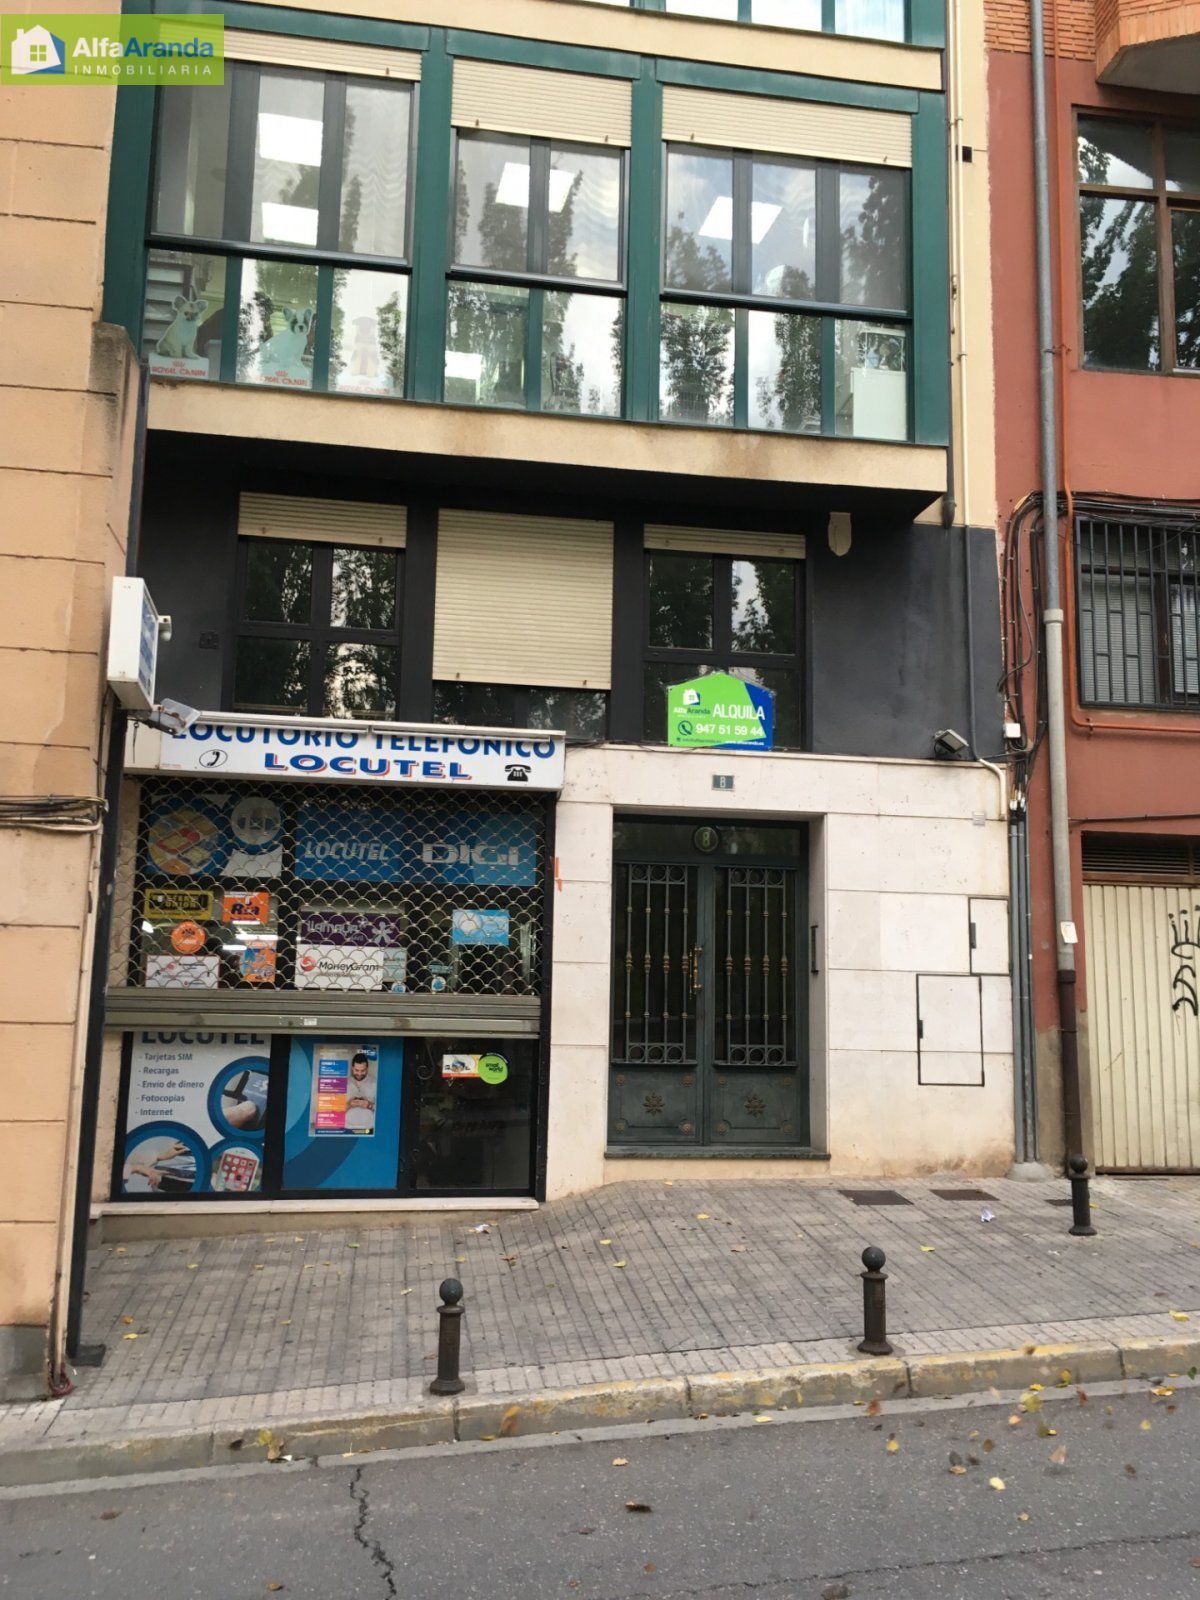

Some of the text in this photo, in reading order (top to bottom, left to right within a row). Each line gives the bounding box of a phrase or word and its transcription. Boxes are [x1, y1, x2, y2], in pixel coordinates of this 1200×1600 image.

[151, 366, 207, 377] ROYAL CANIN
[712, 703, 766, 720] ALQUILA
[172, 722, 359, 749] OCUTORIO
[695, 723, 716, 734] 947
[719, 723, 731, 735] 51
[750, 726, 763, 736] 44
[265, 752, 473, 781] LOCUTEL
[702, 831, 711, 847] 8
[304, 841, 520, 866] LOCUTEL DIGI
[318, 961, 380, 973] MoneyGram
[144, 1053, 193, 1062] Tarjetas SIM
[143, 1067, 179, 1076] Recargas
[166, 1080, 176, 1089] de
[178, 1080, 205, 1089] dinero
[141, 1094, 185, 1103] Fotocopias
[140, 1108, 173, 1116] Internet
